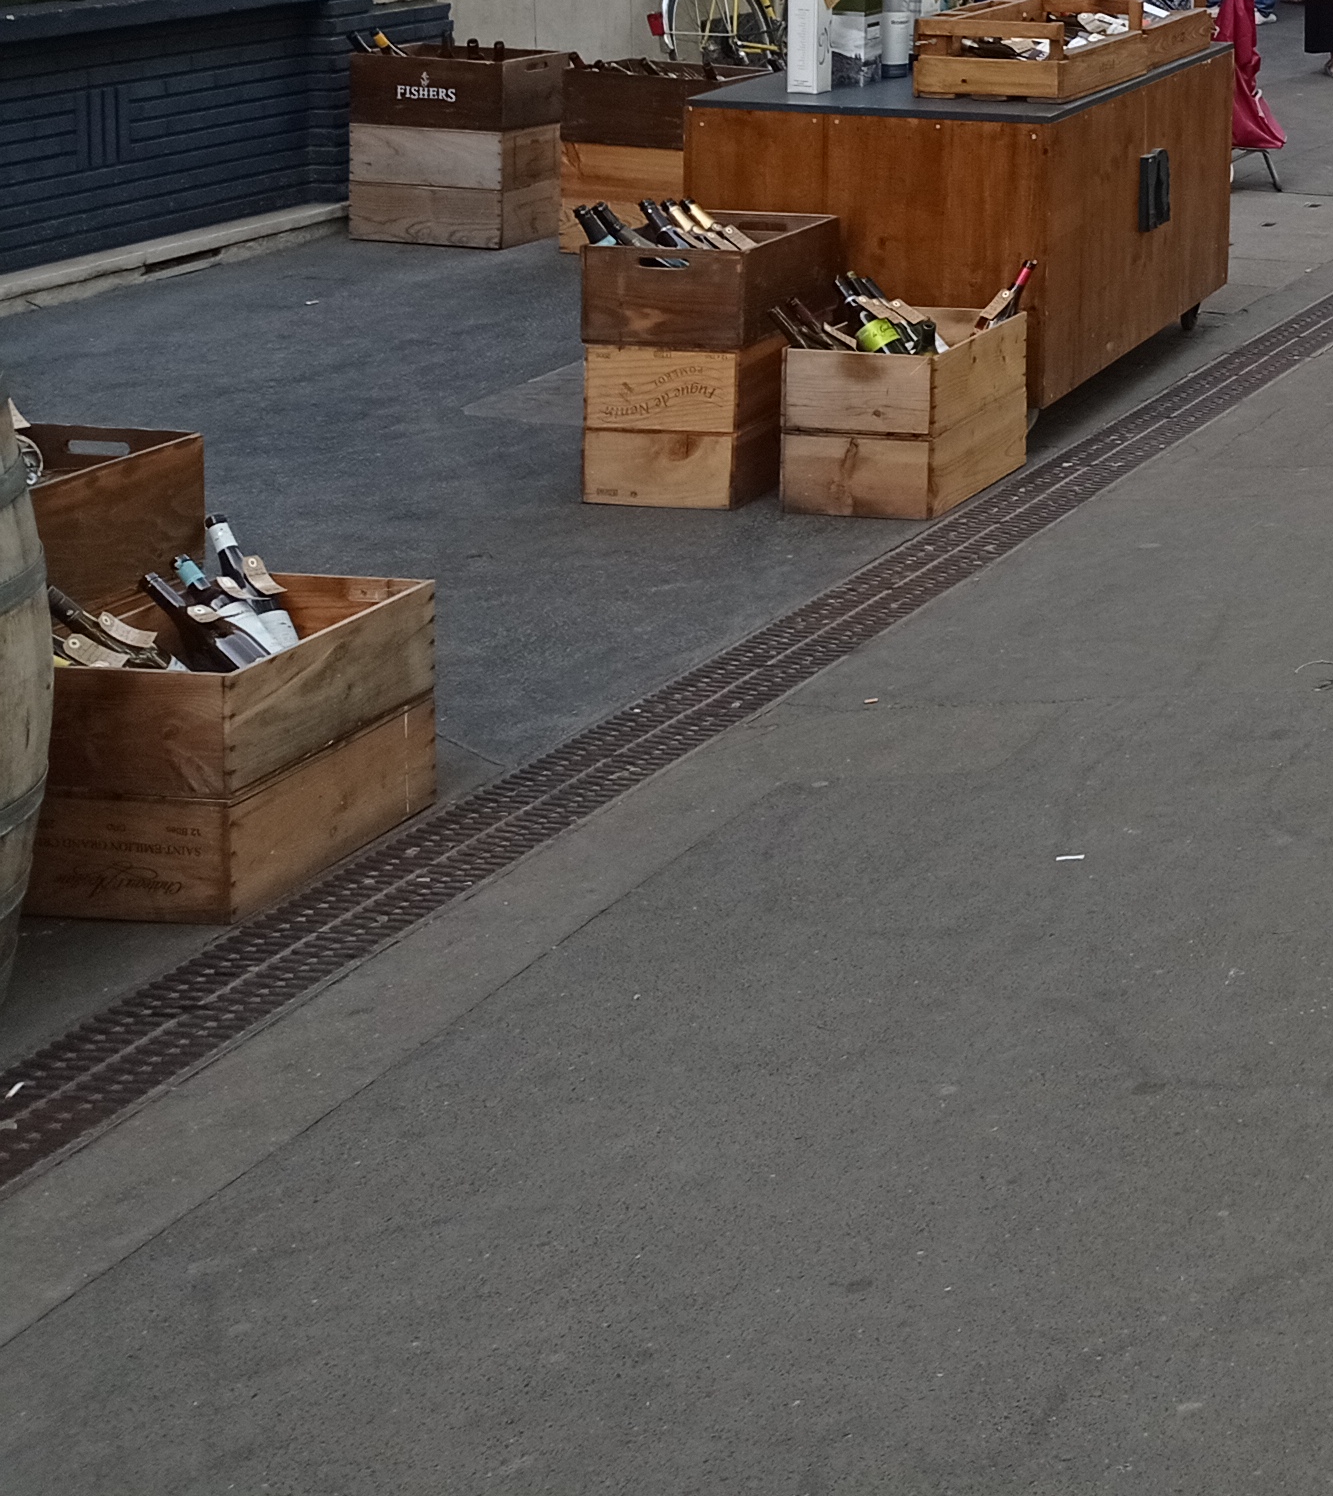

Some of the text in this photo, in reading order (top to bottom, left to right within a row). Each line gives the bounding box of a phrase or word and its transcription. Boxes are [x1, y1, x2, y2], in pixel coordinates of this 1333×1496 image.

[396, 84, 456, 103] FISHERS
[653, 366, 704, 387] POMEROL
[673, 382, 717, 399] Fugue
[654, 393, 670, 409] de
[111, 840, 202, 857] SAINT-EMILION
